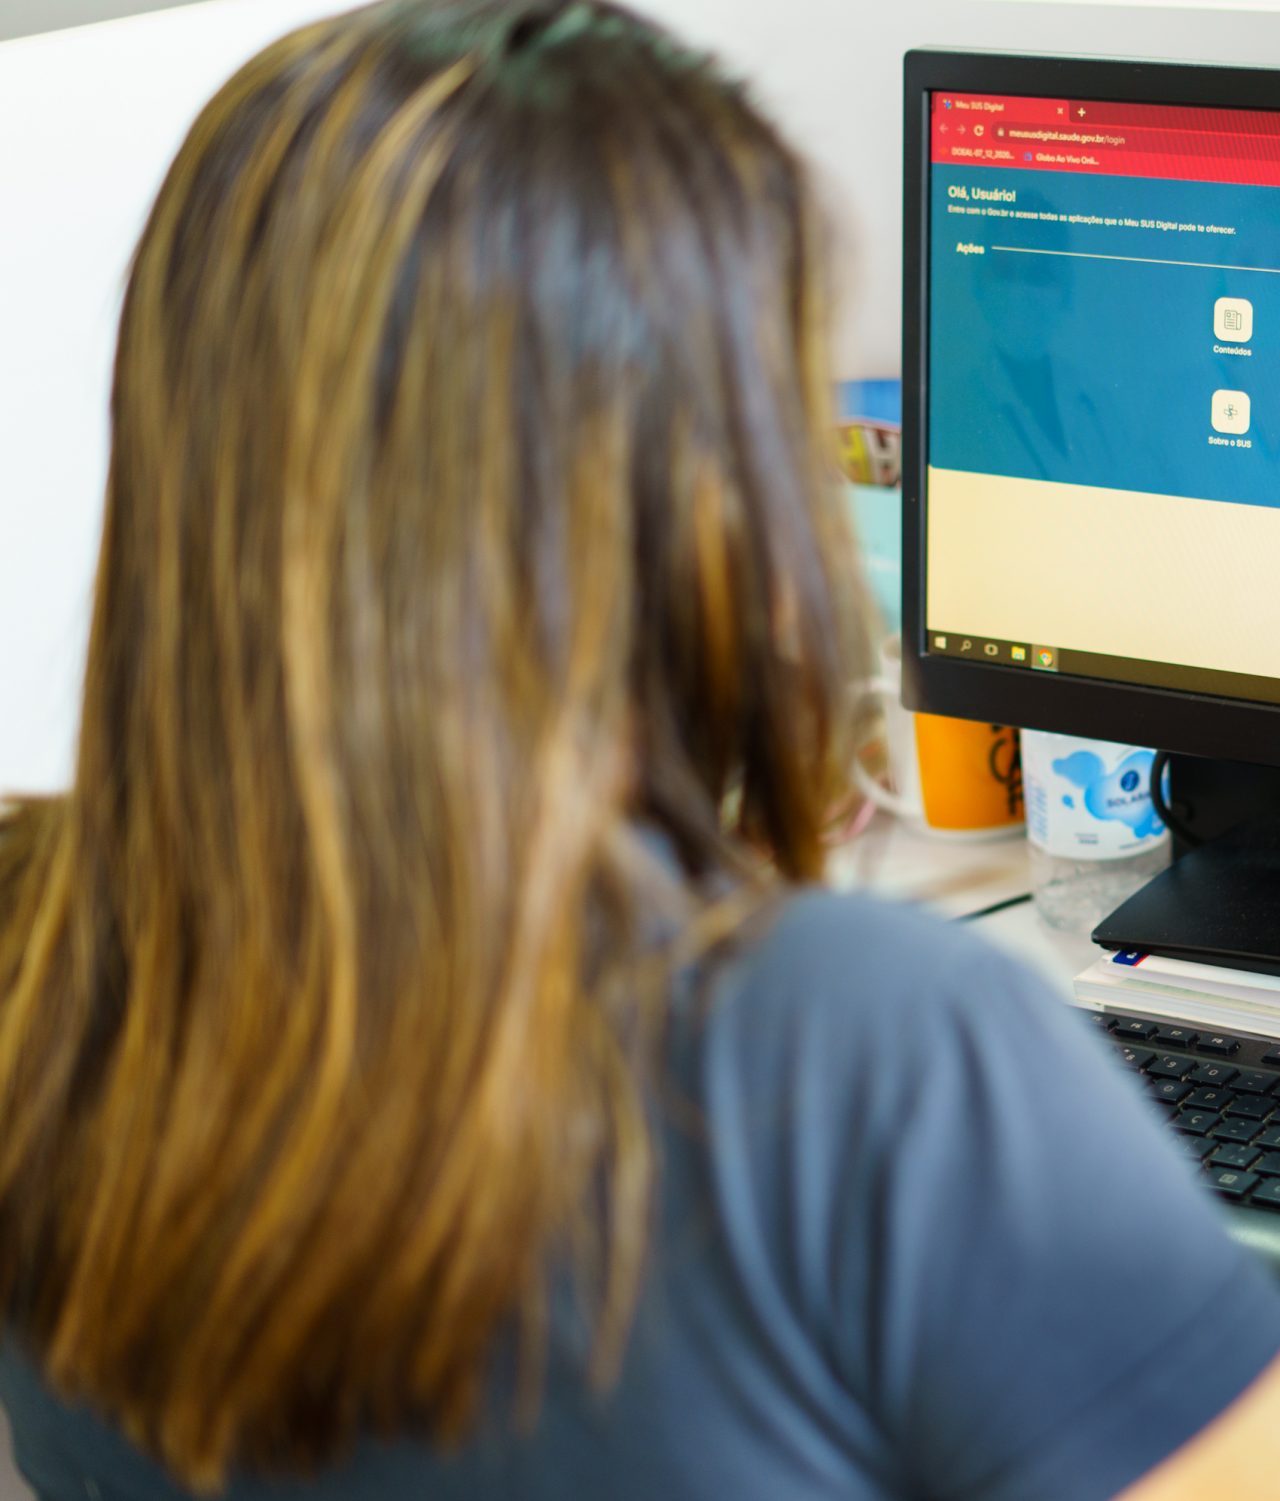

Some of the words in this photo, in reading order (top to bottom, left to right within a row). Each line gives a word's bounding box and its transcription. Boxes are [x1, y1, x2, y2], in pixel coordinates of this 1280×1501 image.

[956, 101, 969, 109] Meu
[984, 102, 1004, 112] Digital
[1009, 129, 1126, 146] meususdigital.saude.gov.br/login
[1036, 152, 1056, 162] Globo
[1056, 154, 1066, 162] Ao
[1066, 154, 1080, 164] Vivo
[948, 186, 969, 200] Olá,
[971, 186, 1016, 202] Usuário!
[948, 204, 964, 214] Entre
[966, 206, 980, 215] com
[988, 208, 1008, 216] Gov.br
[1016, 211, 1038, 219] acesse
[1040, 212, 1058, 220] todas
[1068, 214, 1103, 224] aplicações
[1104, 218, 1116, 226] que
[1124, 218, 1139, 227] Meu
[1140, 220, 1155, 228] SUS
[1156, 220, 1178, 231] Digital
[1178, 222, 1196, 232] pode
[1206, 225, 1236, 235] oferecer.
[956, 242, 984, 255] Ações
[1213, 345, 1252, 356] Conteúdos
[1208, 436, 1229, 446] Sobre
[1230, 439, 1236, 447] o
[1236, 438, 1252, 448] SUS
[1204, 1092, 1216, 1100] P
